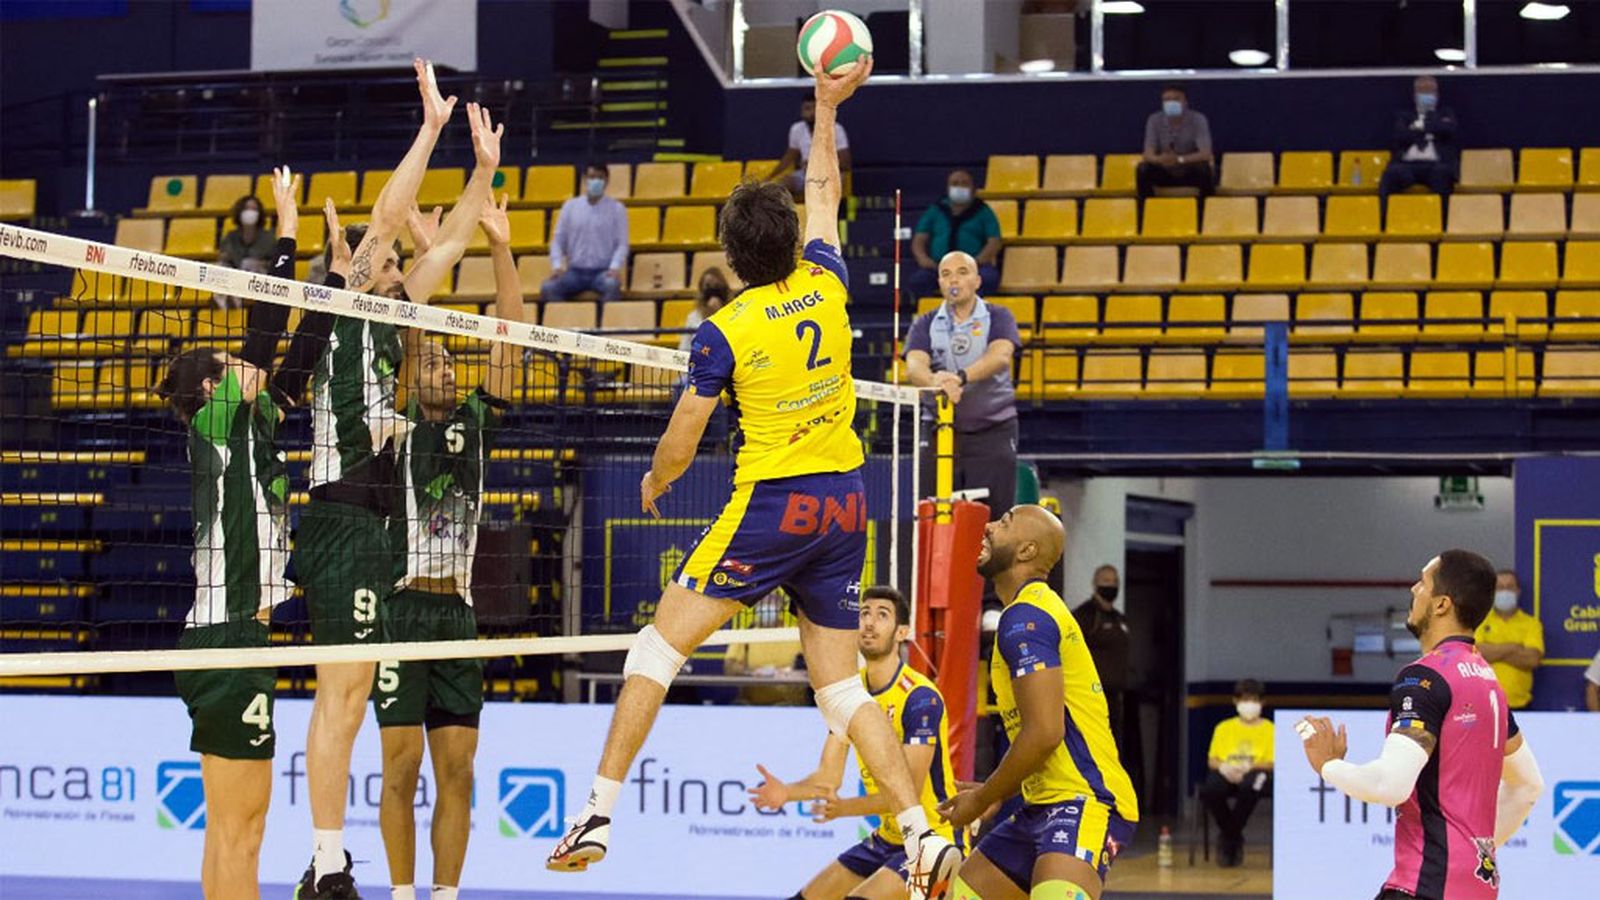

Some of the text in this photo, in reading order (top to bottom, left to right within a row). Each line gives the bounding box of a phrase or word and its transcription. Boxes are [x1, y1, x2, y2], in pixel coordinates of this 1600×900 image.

[765, 290, 824, 320] M.HAGE
[795, 319, 832, 371] 2
[445, 422, 466, 454] 5
[353, 587, 378, 625] 9
[378, 660, 400, 693] 5
[241, 692, 270, 731] 4
[1489, 689, 1499, 749] 1
